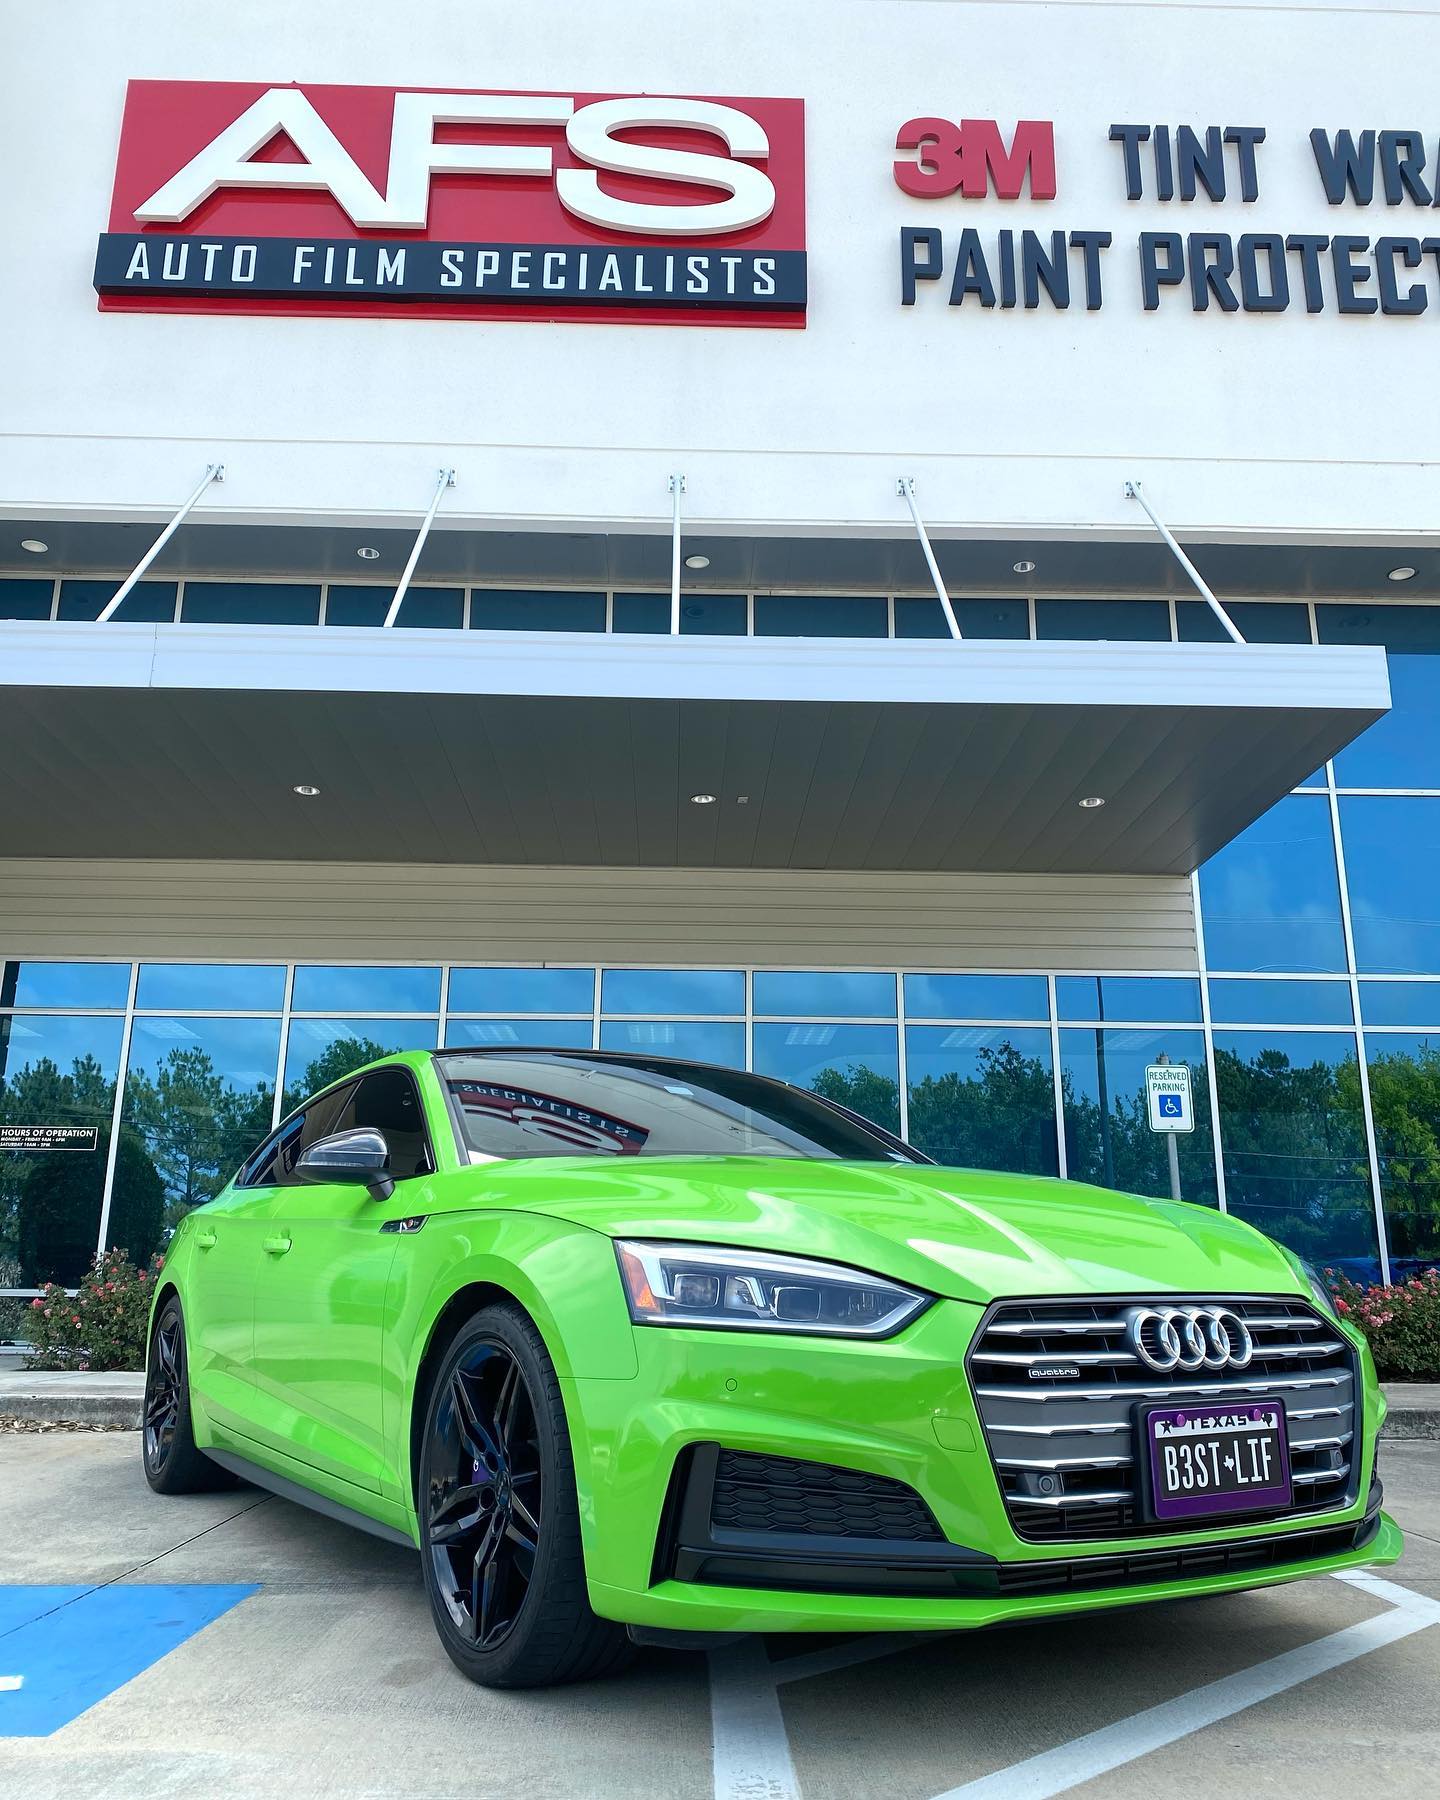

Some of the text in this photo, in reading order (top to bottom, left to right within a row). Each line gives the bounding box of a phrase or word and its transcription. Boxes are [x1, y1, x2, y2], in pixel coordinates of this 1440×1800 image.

[131, 87, 777, 236] AFS
[893, 116, 1440, 207] 3M TINT WR
[125, 242, 777, 296] AUTO FILM SPECIALISTS
[900, 225, 1112, 310] PAINT
[1149, 1071, 1187, 1081] RESERVED
[1152, 1083, 1186, 1092] PARKING
[1, 1129, 94, 1138] HOURS OF OPERATION
[1031, 1368, 1078, 1377] quattro
[1187, 1415, 1248, 1430] TEXAS
[1164, 1437, 1272, 1492] B3ST LIF
